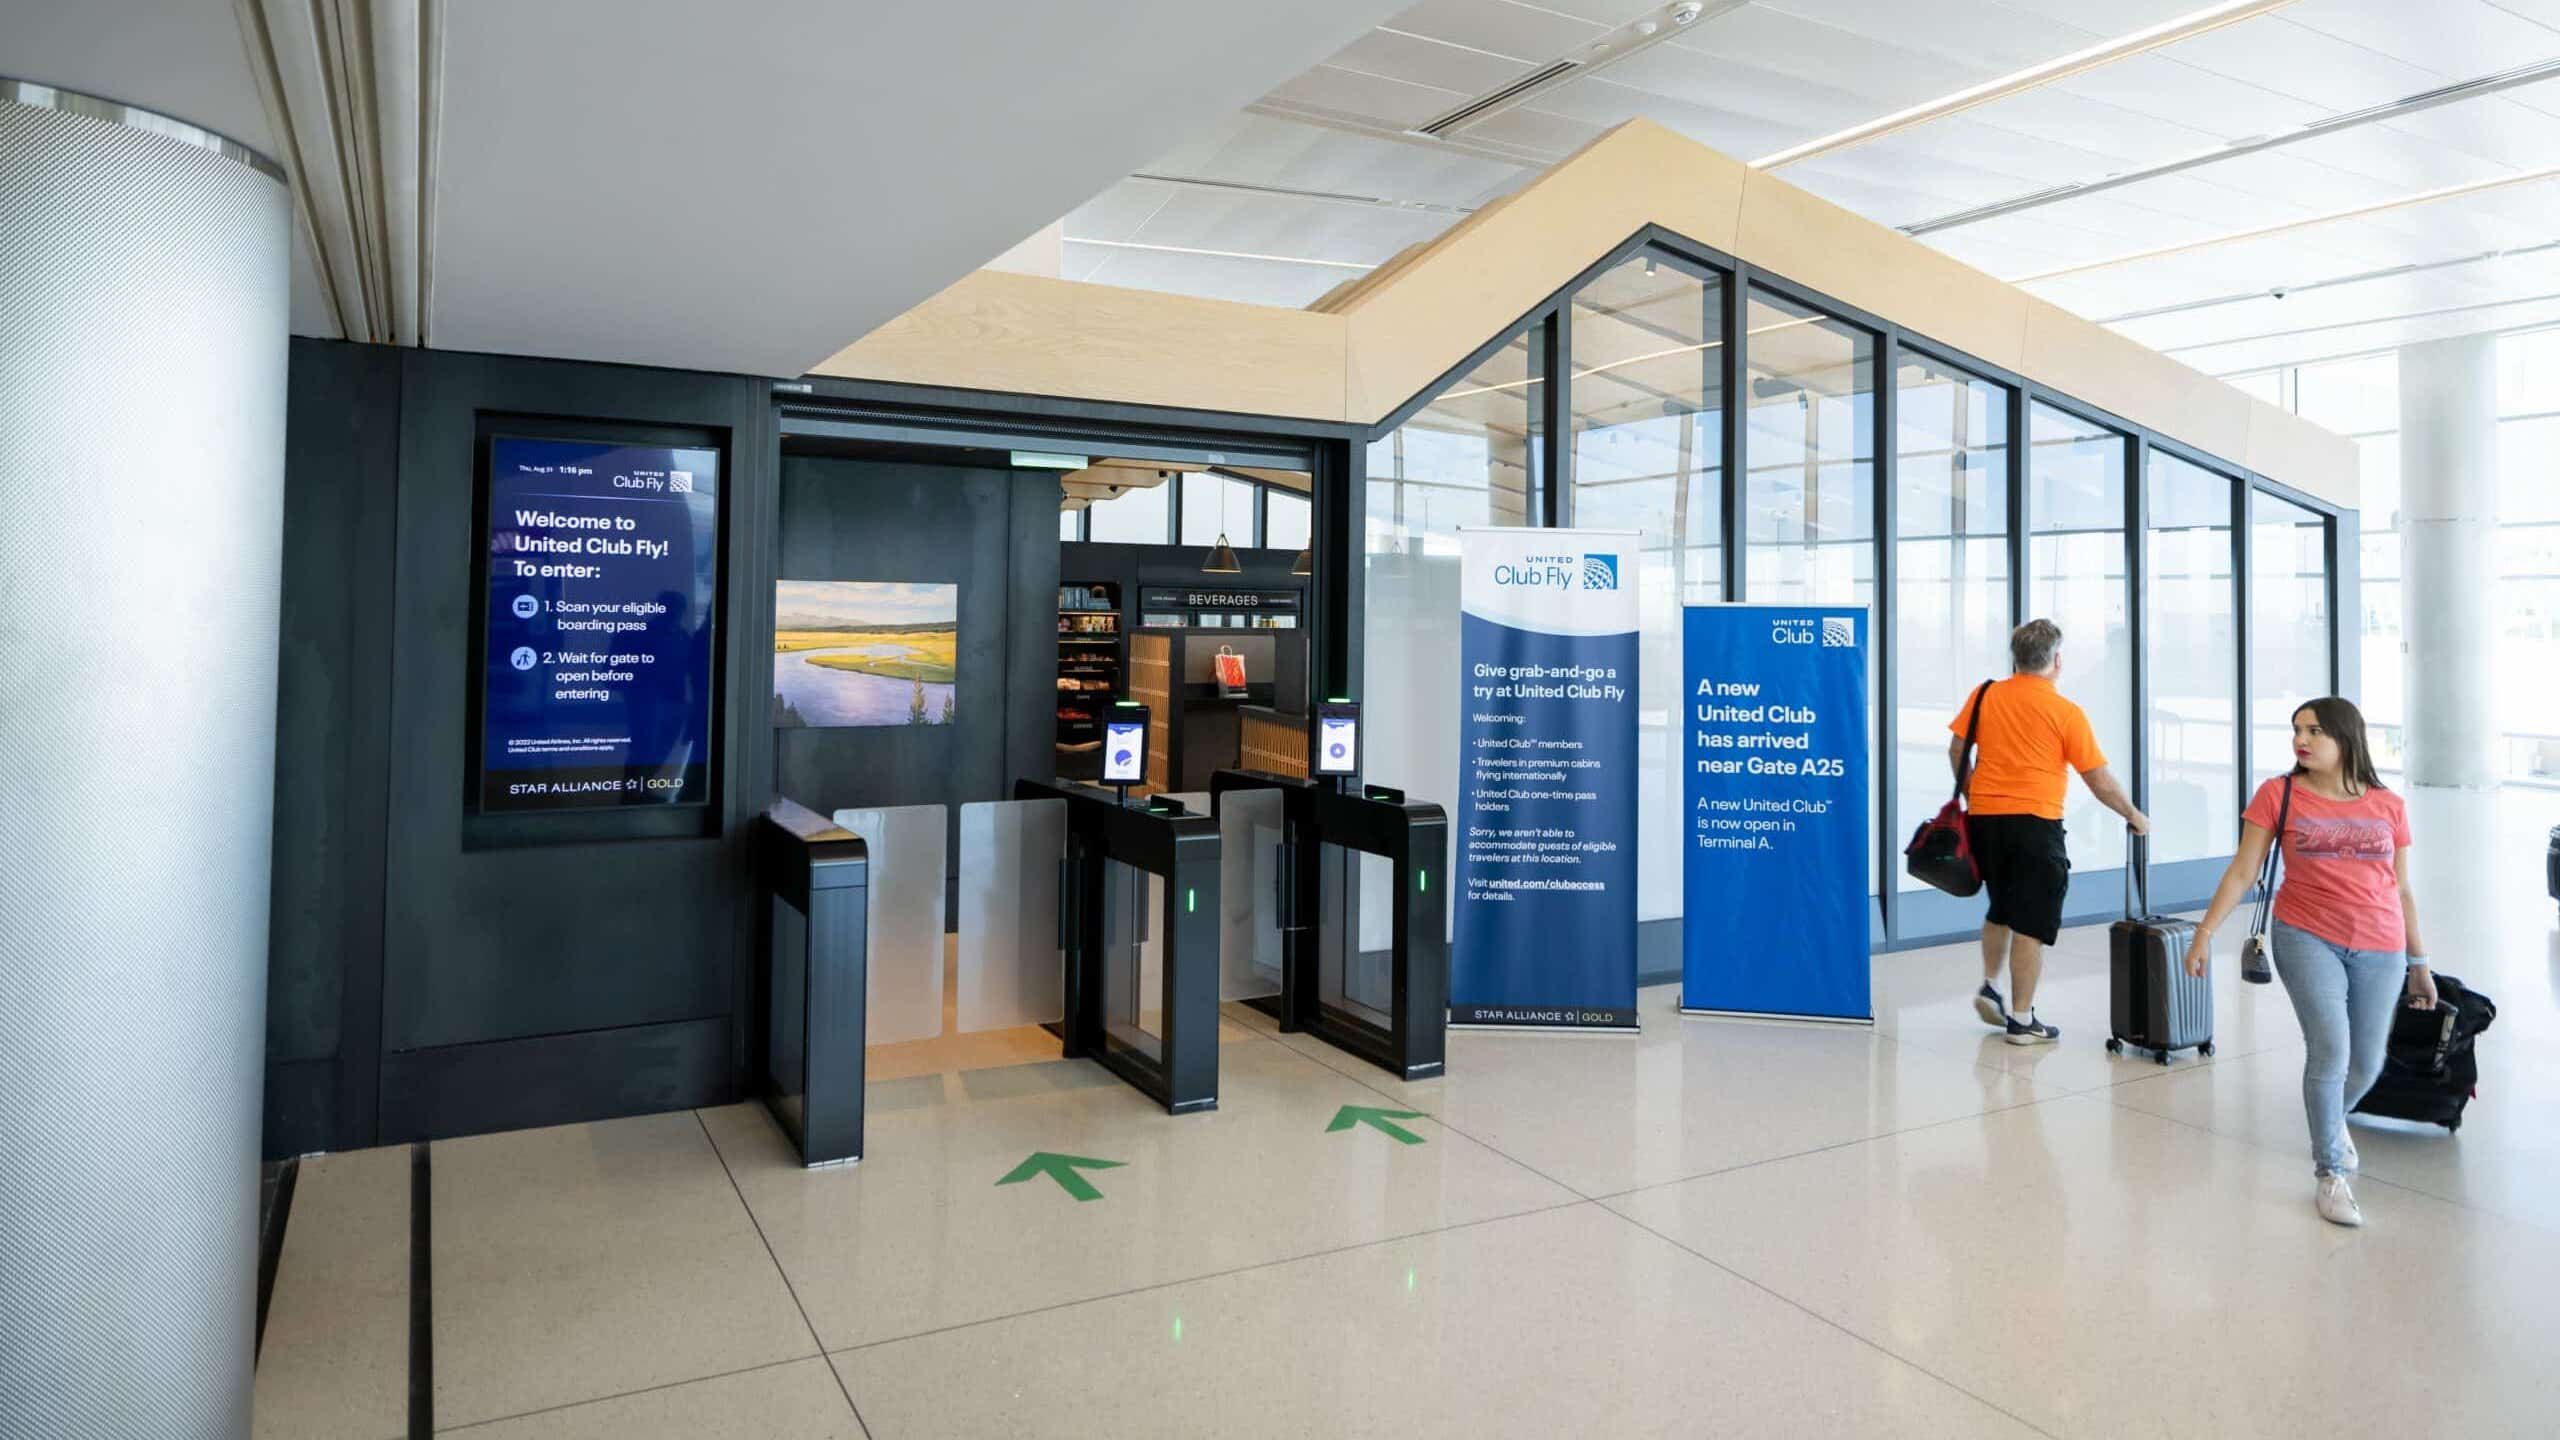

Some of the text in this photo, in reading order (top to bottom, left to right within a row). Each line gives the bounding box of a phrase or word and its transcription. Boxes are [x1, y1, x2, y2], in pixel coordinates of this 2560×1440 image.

[578, 468, 593, 477] pm
[613, 475, 665, 492] Club Fly
[515, 510, 636, 531] Welcome to
[514, 535, 669, 560] United Club Fly!
[1526, 556, 1573, 564] UNITED
[514, 560, 601, 579] To enter:
[1495, 565, 1573, 590] Club Fly
[1189, 594, 1259, 606] BEVERAGES
[544, 600, 667, 616] 1. Scan your eligible
[557, 619, 647, 633] boarding pass
[1772, 627, 1815, 644] Club
[542, 651, 655, 666] 2. Wait for gate to
[556, 669, 634, 684] open before
[1474, 664, 1616, 681] Give grab-and-go a
[555, 688, 610, 701] entering
[1473, 685, 1625, 702] try at United Club Fly
[1697, 678, 1760, 697] A new
[1472, 713, 1527, 725] Welcoming:
[1697, 704, 1816, 724] United Club
[1477, 738, 1508, 749] United
[1538, 740, 1583, 749] members
[1698, 730, 1809, 750] has arrived
[1477, 757, 1601, 770] Travelers in premium cabins
[1698, 756, 1845, 777] near Gate A25
[1476, 771, 1567, 782] flying internationally
[510, 777, 684, 795] STAR ALLIANCE GOLD
[1476, 789, 1597, 801] United Club one-time pass
[1475, 802, 1510, 812] holders
[1697, 797, 1708, 810] A
[1711, 800, 1740, 811] new
[1743, 799, 1790, 812] United
[1470, 827, 1497, 838] Sorry,
[1498, 829, 1512, 837] we
[1542, 828, 1563, 838] able
[1564, 829, 1575, 838] to
[1697, 817, 1795, 833] is now open in
[1469, 840, 1617, 853] accommodate guests of eligible
[1697, 834, 1774, 850] Terminal A.
[1469, 853, 1582, 864] travelers at this location.
[1468, 878, 1605, 890] Visit united.com/clubaccess
[1468, 891, 1515, 901] for details.
[1475, 1010, 1613, 1022] STAR ALLIANCE GOLD
